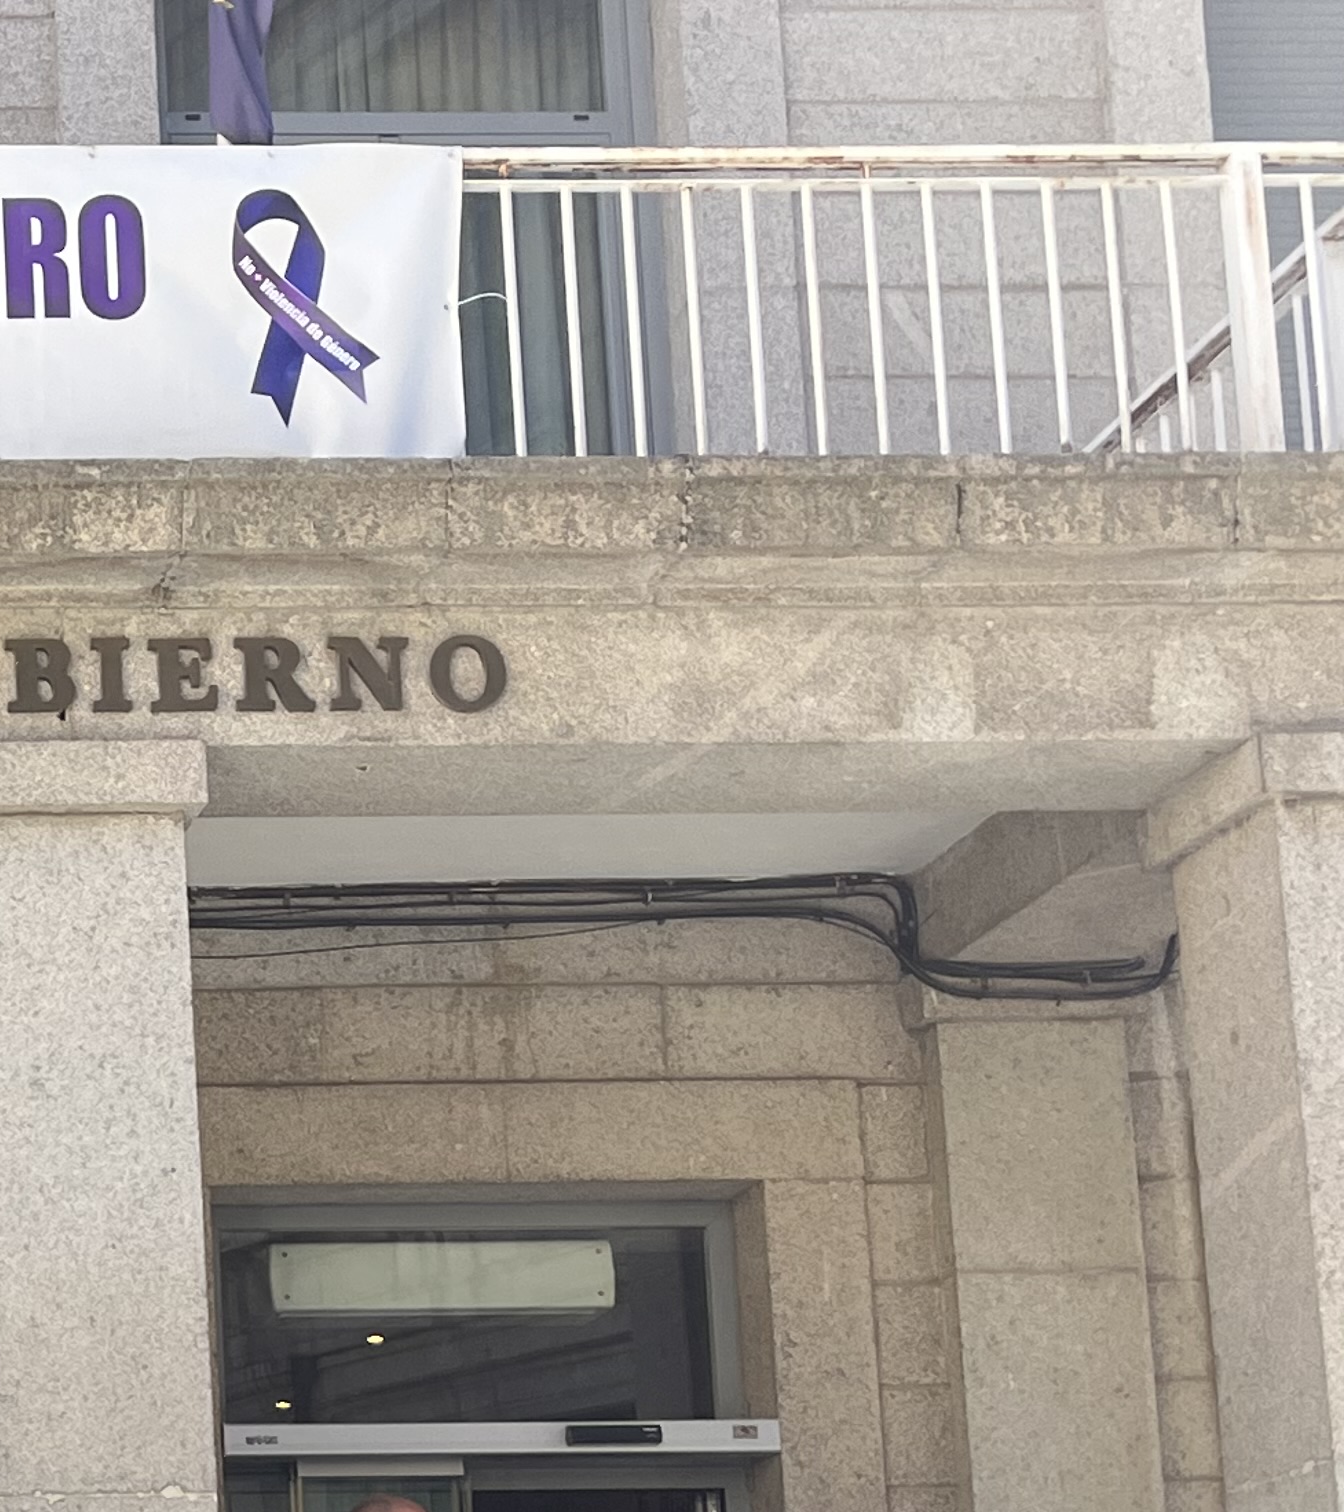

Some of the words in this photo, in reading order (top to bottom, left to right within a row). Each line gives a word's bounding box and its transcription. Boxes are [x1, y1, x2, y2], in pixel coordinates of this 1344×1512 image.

[238, 255, 256, 276] No
[259, 278, 310, 328] Violencia
[306, 322, 324, 341] de
